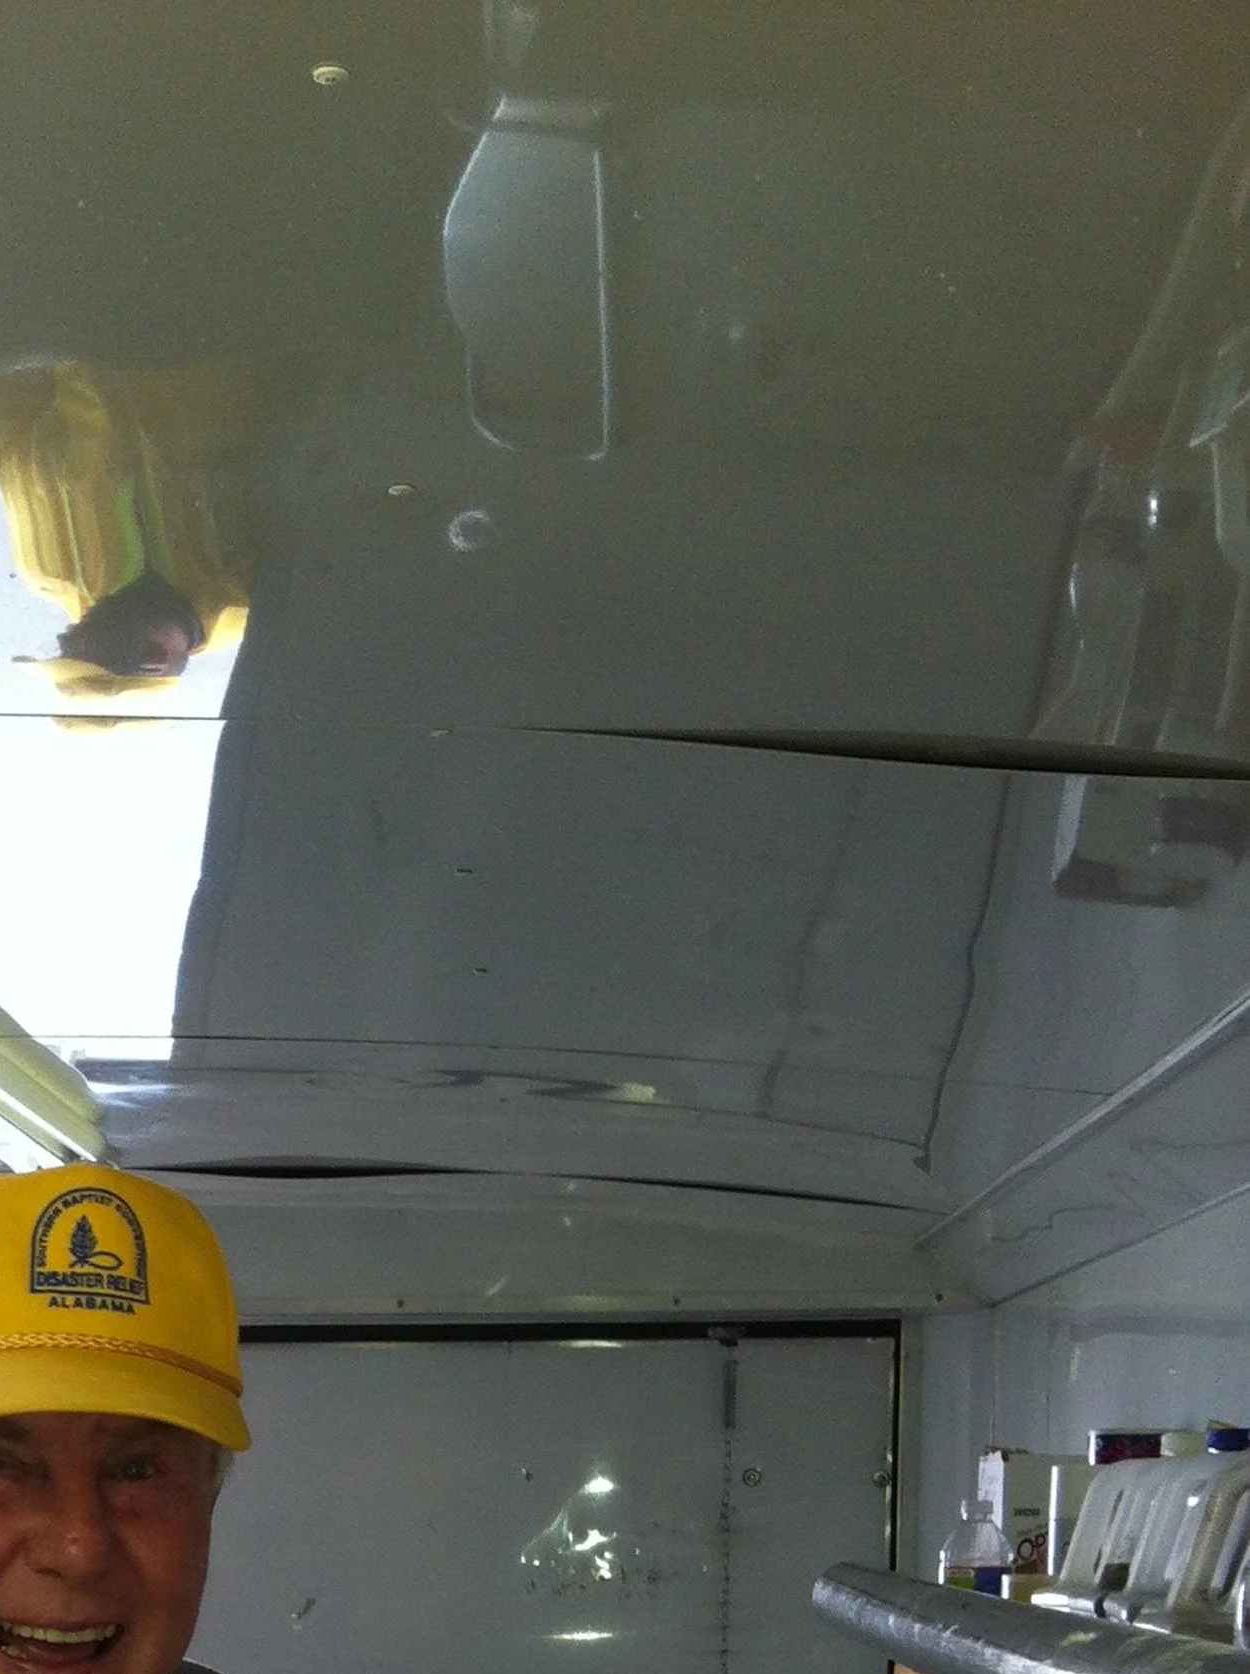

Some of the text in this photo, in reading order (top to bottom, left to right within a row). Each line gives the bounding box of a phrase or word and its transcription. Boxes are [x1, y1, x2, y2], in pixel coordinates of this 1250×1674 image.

[61, 1193, 114, 1210] BAPTIST
[36, 1271, 147, 1295] DISASTER RELIEF
[48, 1296, 136, 1314] ALABAMA
